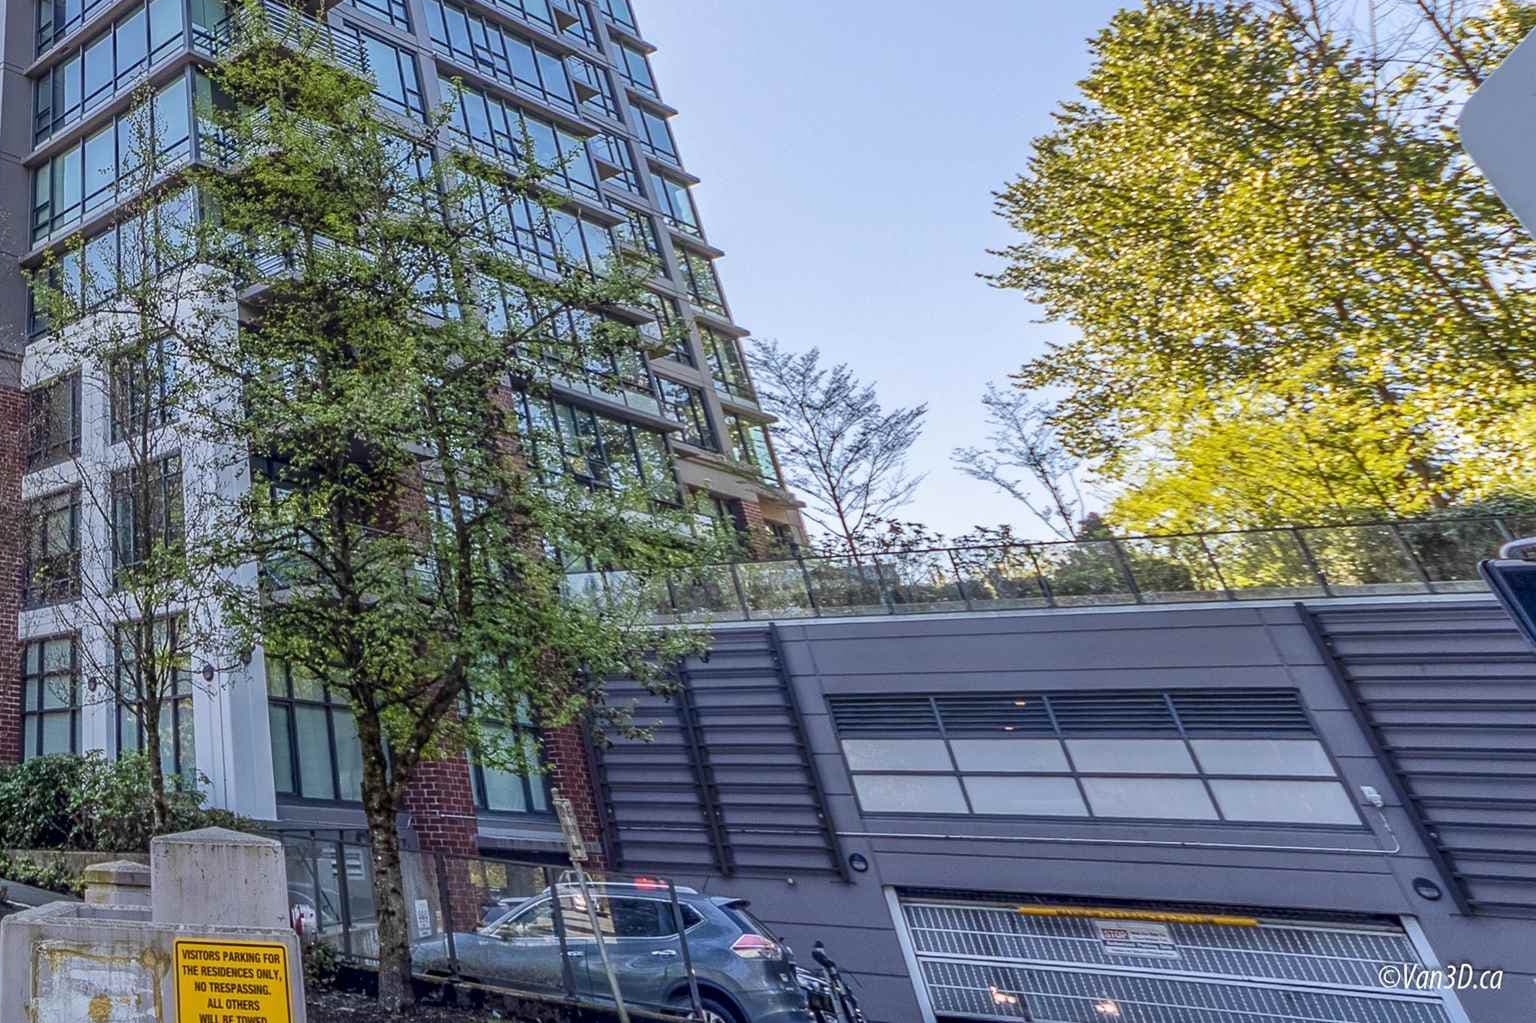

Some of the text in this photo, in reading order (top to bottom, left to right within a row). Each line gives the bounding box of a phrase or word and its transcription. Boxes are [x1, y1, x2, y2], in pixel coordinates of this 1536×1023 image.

[182, 949, 281, 964] VISITORS PARKING FOR
[182, 965, 282, 982] THE RESIDENCES ONLY,
[194, 981, 272, 996] NO TRESPASSING.
[207, 998, 261, 1011] ALL OTHERS
